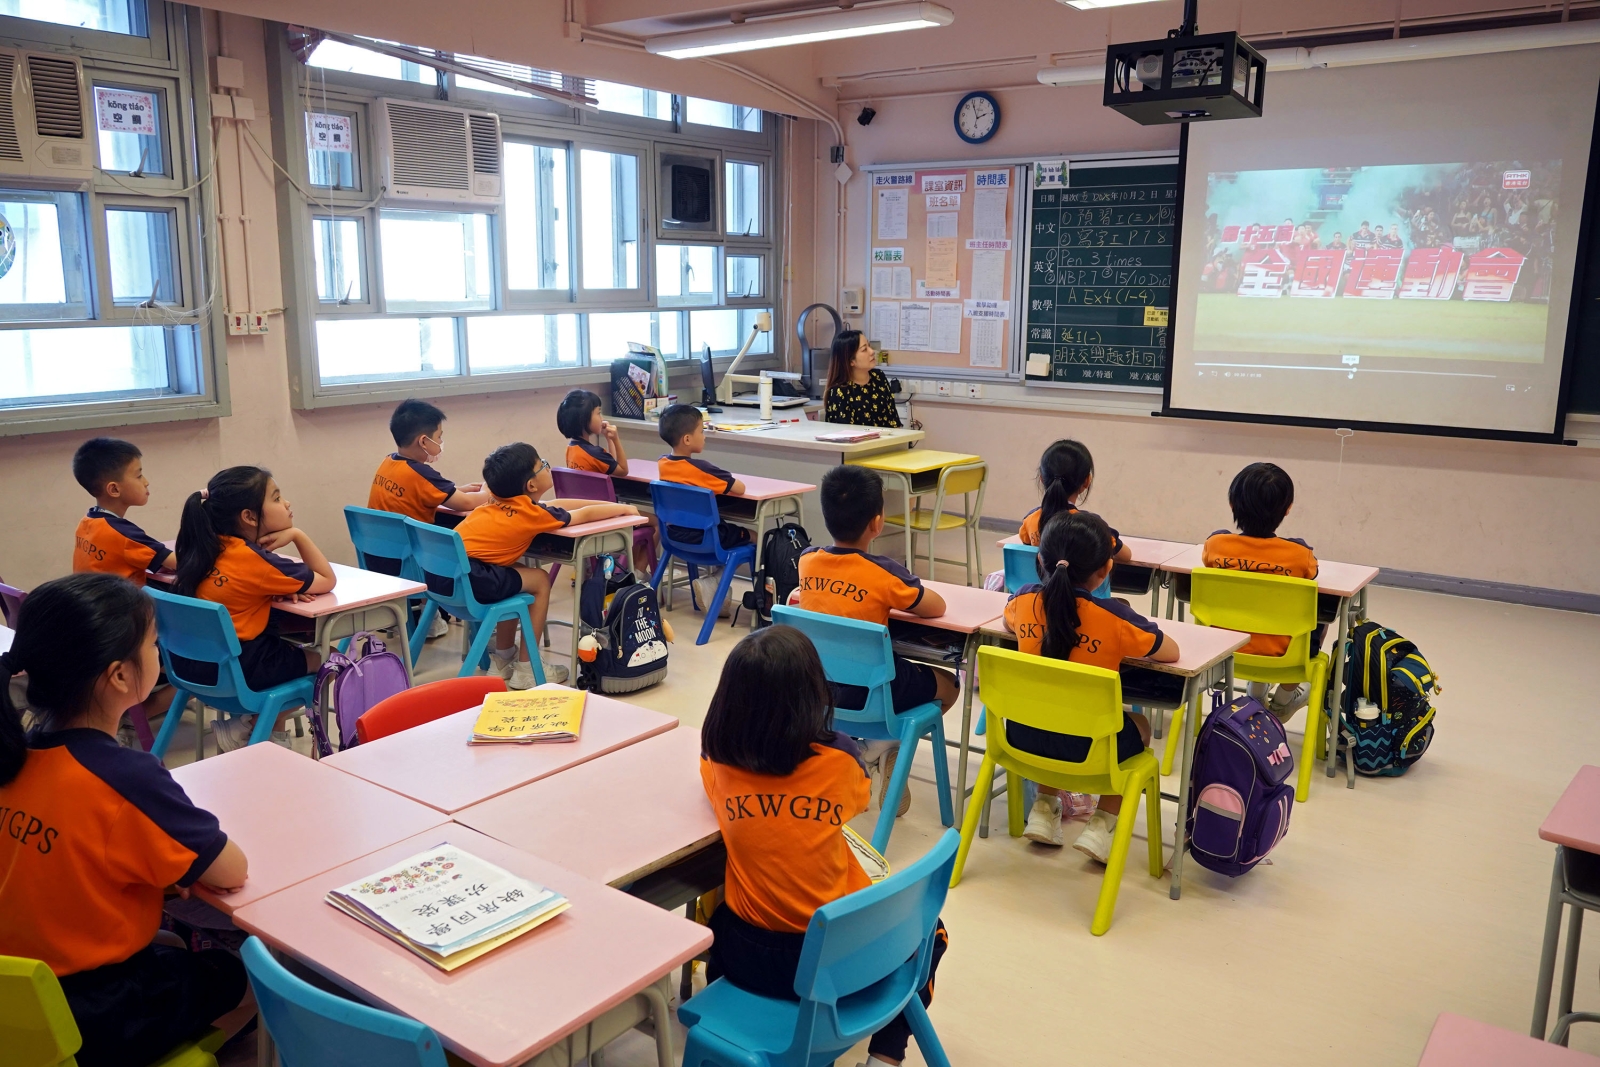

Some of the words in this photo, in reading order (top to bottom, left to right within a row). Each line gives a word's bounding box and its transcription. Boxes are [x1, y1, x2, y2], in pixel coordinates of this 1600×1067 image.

[875, 175, 914, 185] 走火警路線
[924, 179, 964, 192] 課室資訊
[976, 173, 1007, 186] 時間表
[928, 195, 959, 208] 班名單
[1040, 194, 1055, 203] 日期
[1035, 222, 1056, 234] 中文
[874, 250, 903, 262] 校曆表
[1061, 249, 1083, 267] Pen
[1091, 251, 1101, 265] 3
[1105, 250, 1142, 267] times
[1033, 260, 1055, 273] 英文
[1237, 247, 1528, 302] 全國運動會
[1031, 299, 1053, 311] 數學
[1030, 327, 1052, 340] 常識
[634, 616, 650, 631] THE
[634, 626, 657, 644] MOON
[725, 793, 844, 827] SKWGPS
[411, 882, 489, 917] 功課袋
[426, 887, 525, 937] 缺席同學
